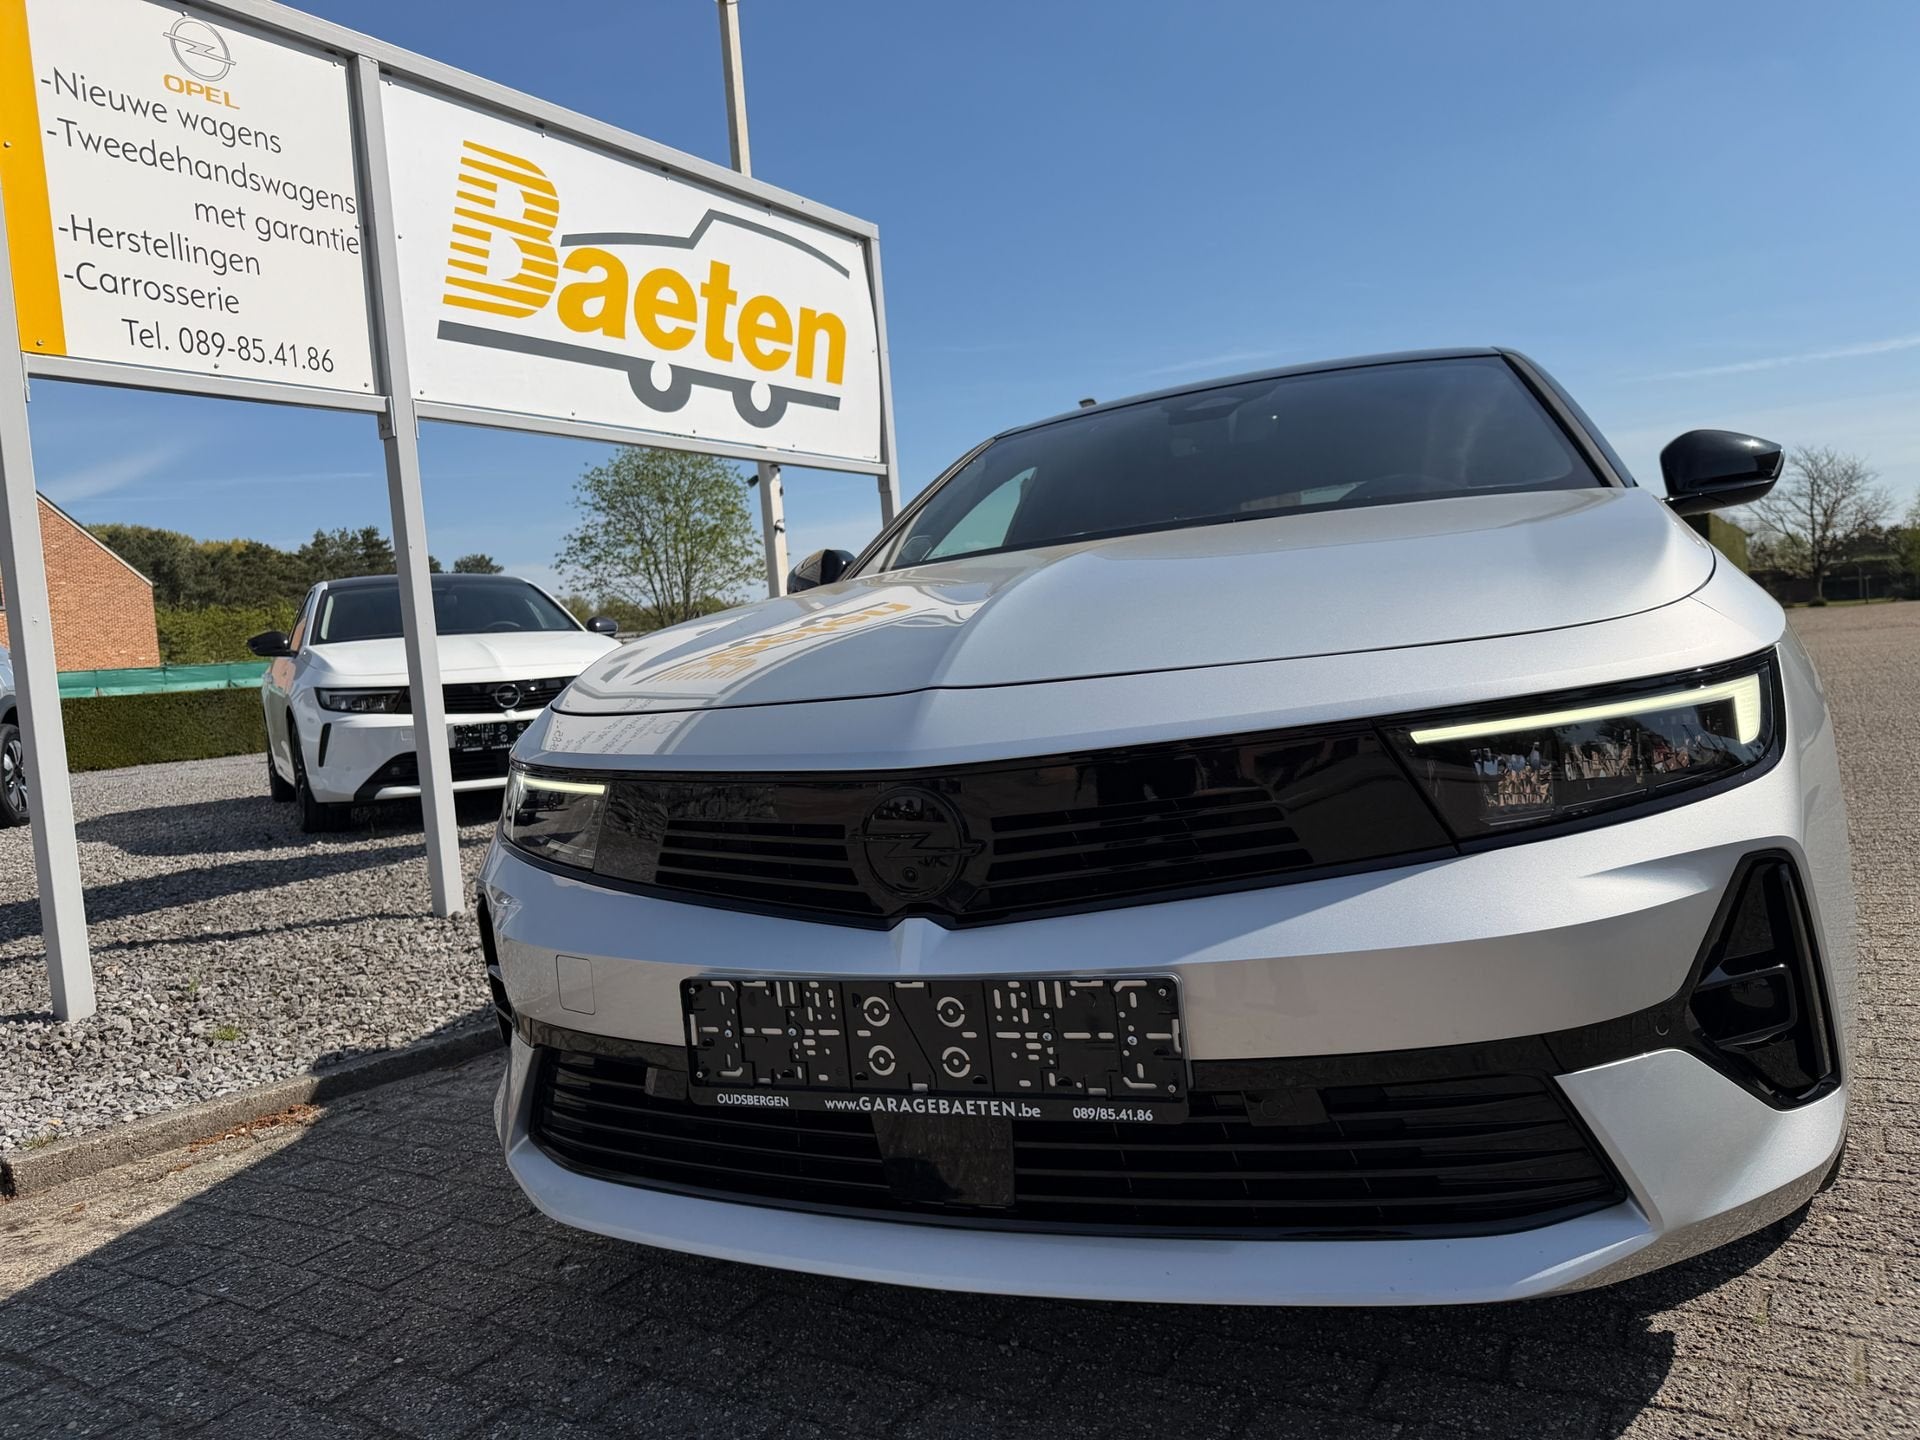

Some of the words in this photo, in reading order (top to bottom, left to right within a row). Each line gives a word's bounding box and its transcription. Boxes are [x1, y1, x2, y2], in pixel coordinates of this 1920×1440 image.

[41, 67, 168, 123] -Nieuwe
[177, 107, 282, 154] wagens
[163, 74, 240, 110] OPEL
[46, 118, 357, 215] -Tweedehandswagens
[58, 214, 261, 276] -Herstellingen
[194, 202, 246, 231] met
[255, 215, 360, 254] garantie
[63, 263, 240, 314] -Carrosserie
[443, 140, 847, 386] Baeten
[121, 318, 170, 351] Tel.
[179, 327, 335, 373] 089-85.41.86
[716, 1093, 790, 1108] OUDSBERGEN
[824, 1096, 1042, 1118] www.GARAGEBAETEN.be
[1072, 1107, 1154, 1122] 089/85.41.86
